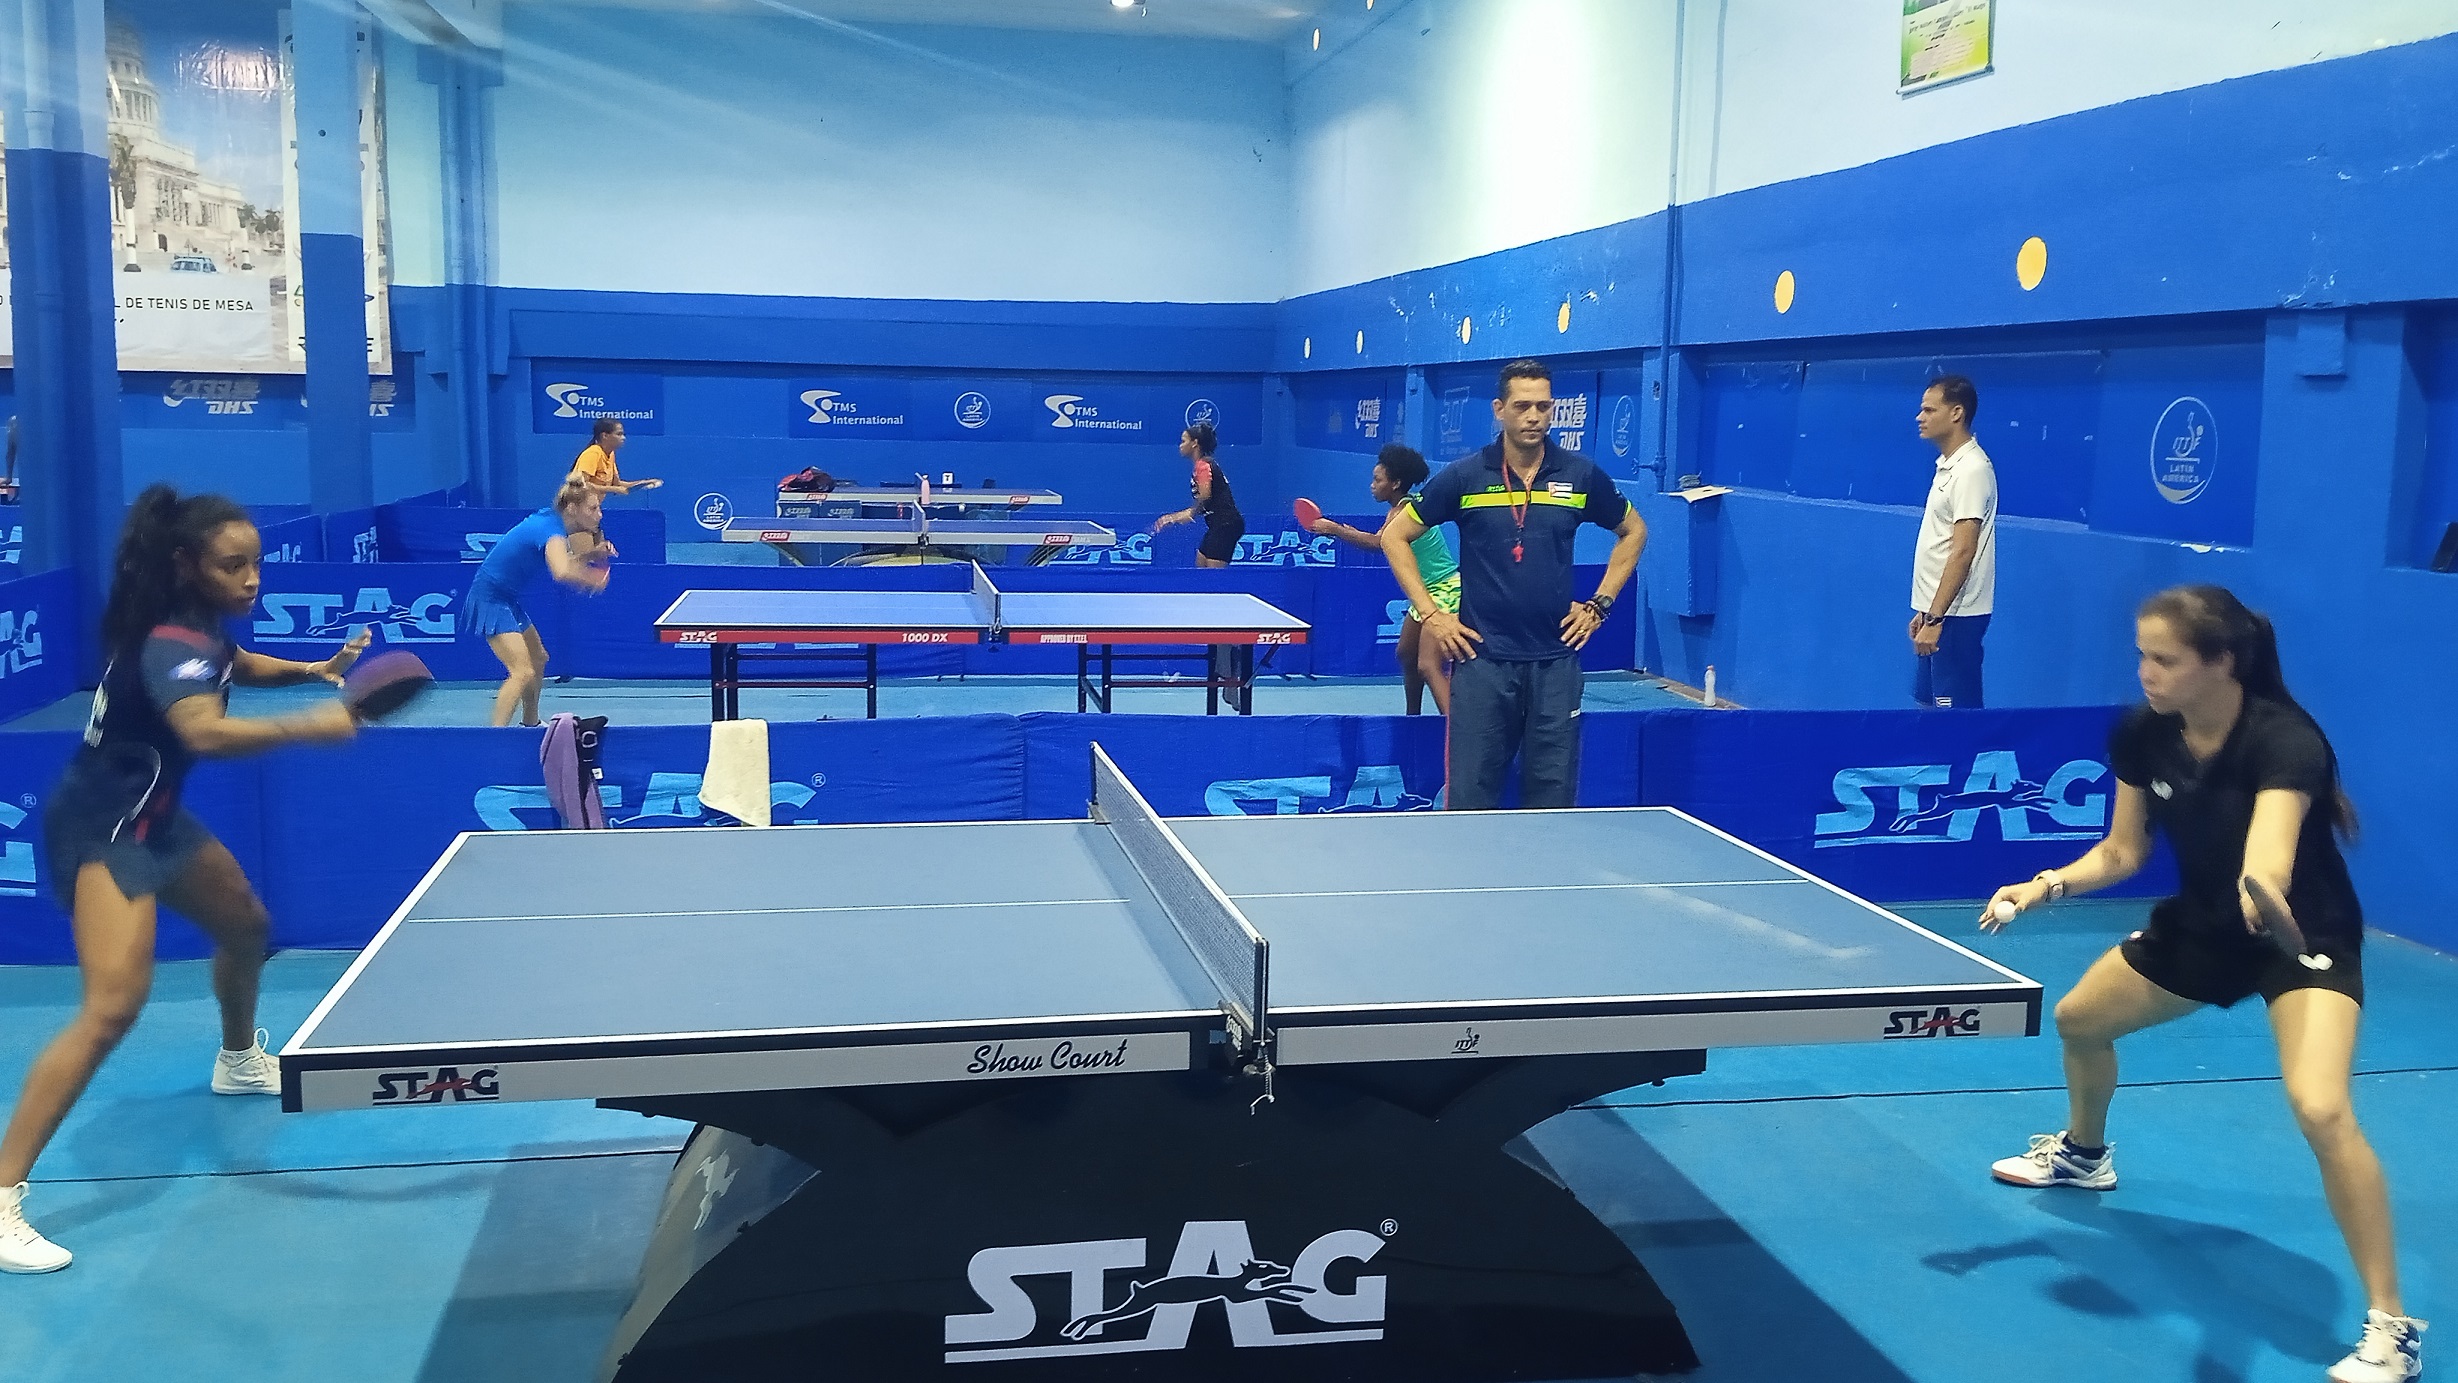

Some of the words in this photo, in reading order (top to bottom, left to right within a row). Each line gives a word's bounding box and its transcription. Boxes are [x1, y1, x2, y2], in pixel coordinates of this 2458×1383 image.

[126, 298, 143, 308] DE
[148, 298, 188, 310] TENIS
[193, 299, 210, 310] DE
[216, 300, 254, 311] MESA
[205, 401, 259, 414] DHS
[579, 396, 604, 407] TMS
[832, 402, 857, 413] TMS
[579, 409, 654, 419] International
[1075, 406, 1098, 417] TMS
[832, 415, 904, 425] International
[1075, 418, 1142, 430] International
[1558, 431, 1586, 451] DHS
[2169, 464, 2195, 473] LATIN
[2162, 474, 2199, 483] AMERICA
[253, 588, 455, 643] STAG
[679, 630, 718, 642] STAG
[902, 632, 930, 643] 1000
[931, 632, 949, 643] DX
[1257, 632, 1291, 644] STAG
[1814, 751, 2109, 849] STAG
[1883, 1007, 1980, 1039] STAG
[967, 1043, 1043, 1074] Show
[1050, 1038, 1128, 1070] Court
[372, 1067, 499, 1106] STAG
[945, 1220, 1387, 1363] STAG
